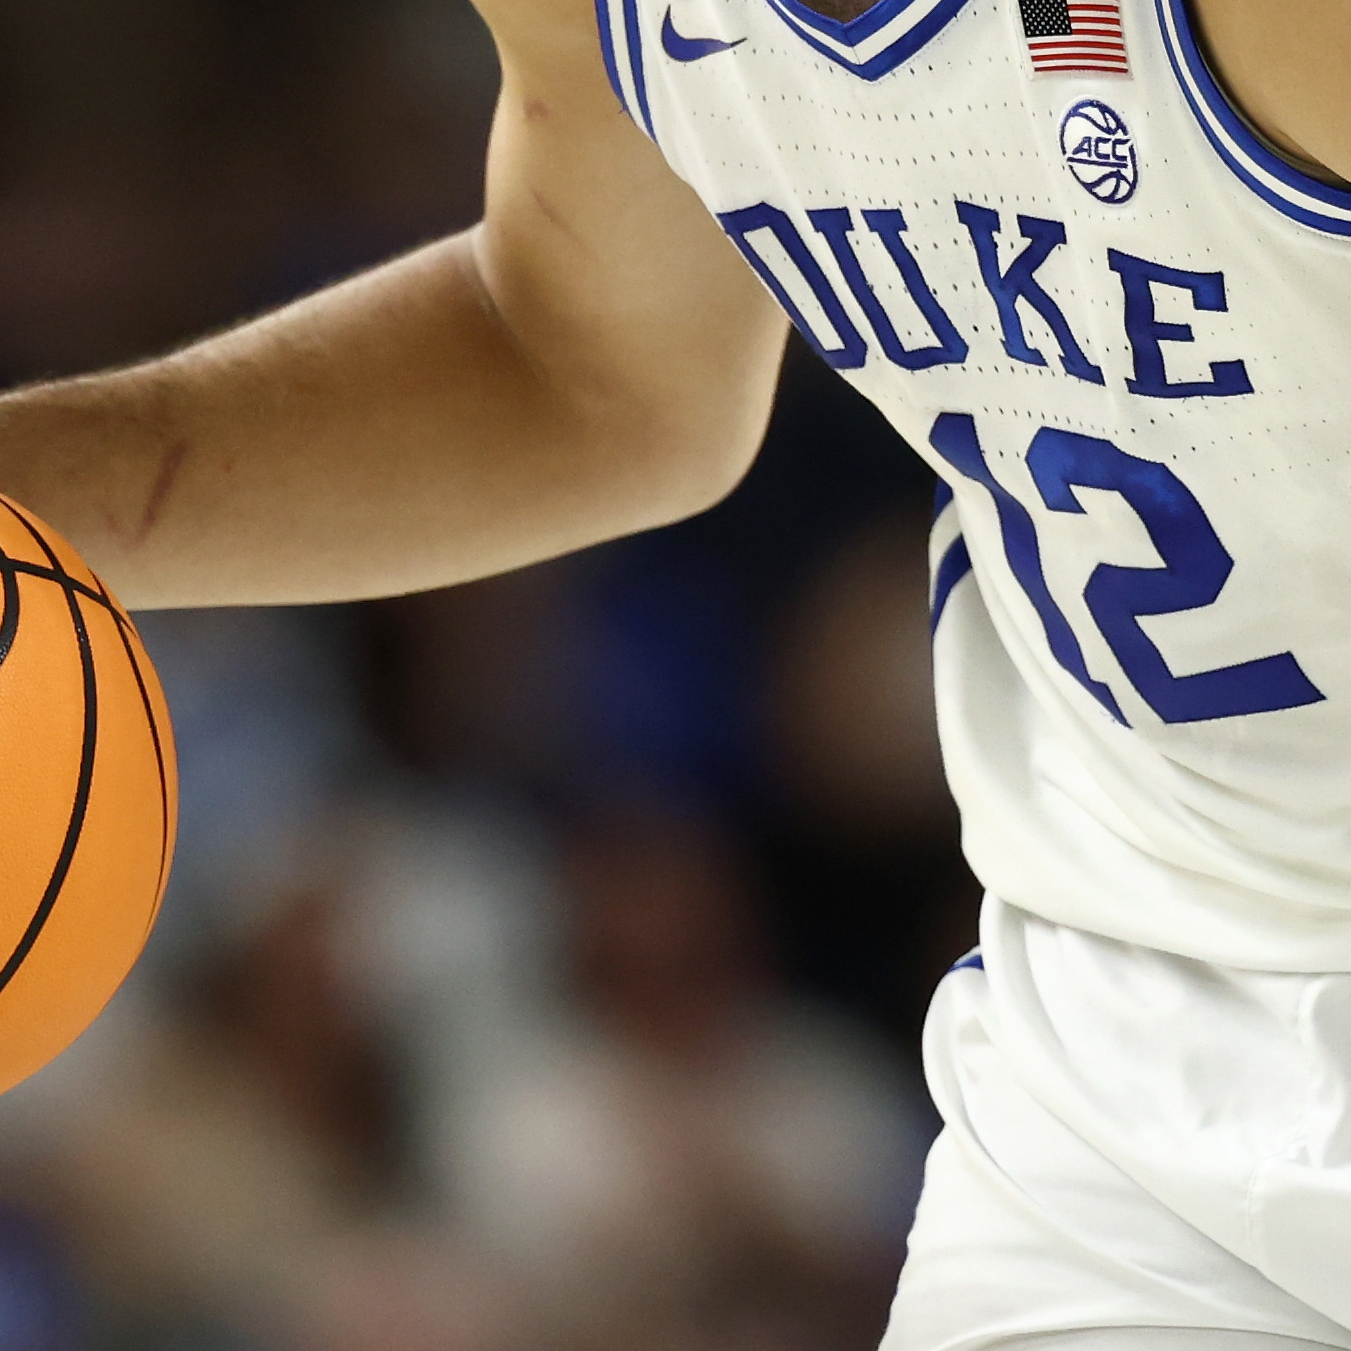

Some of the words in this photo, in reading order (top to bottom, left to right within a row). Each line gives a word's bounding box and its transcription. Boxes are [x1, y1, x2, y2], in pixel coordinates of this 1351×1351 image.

[1072, 136, 1131, 162] ACC
[715, 201, 1255, 398] DUKE
[928, 411, 1327, 729] 12
